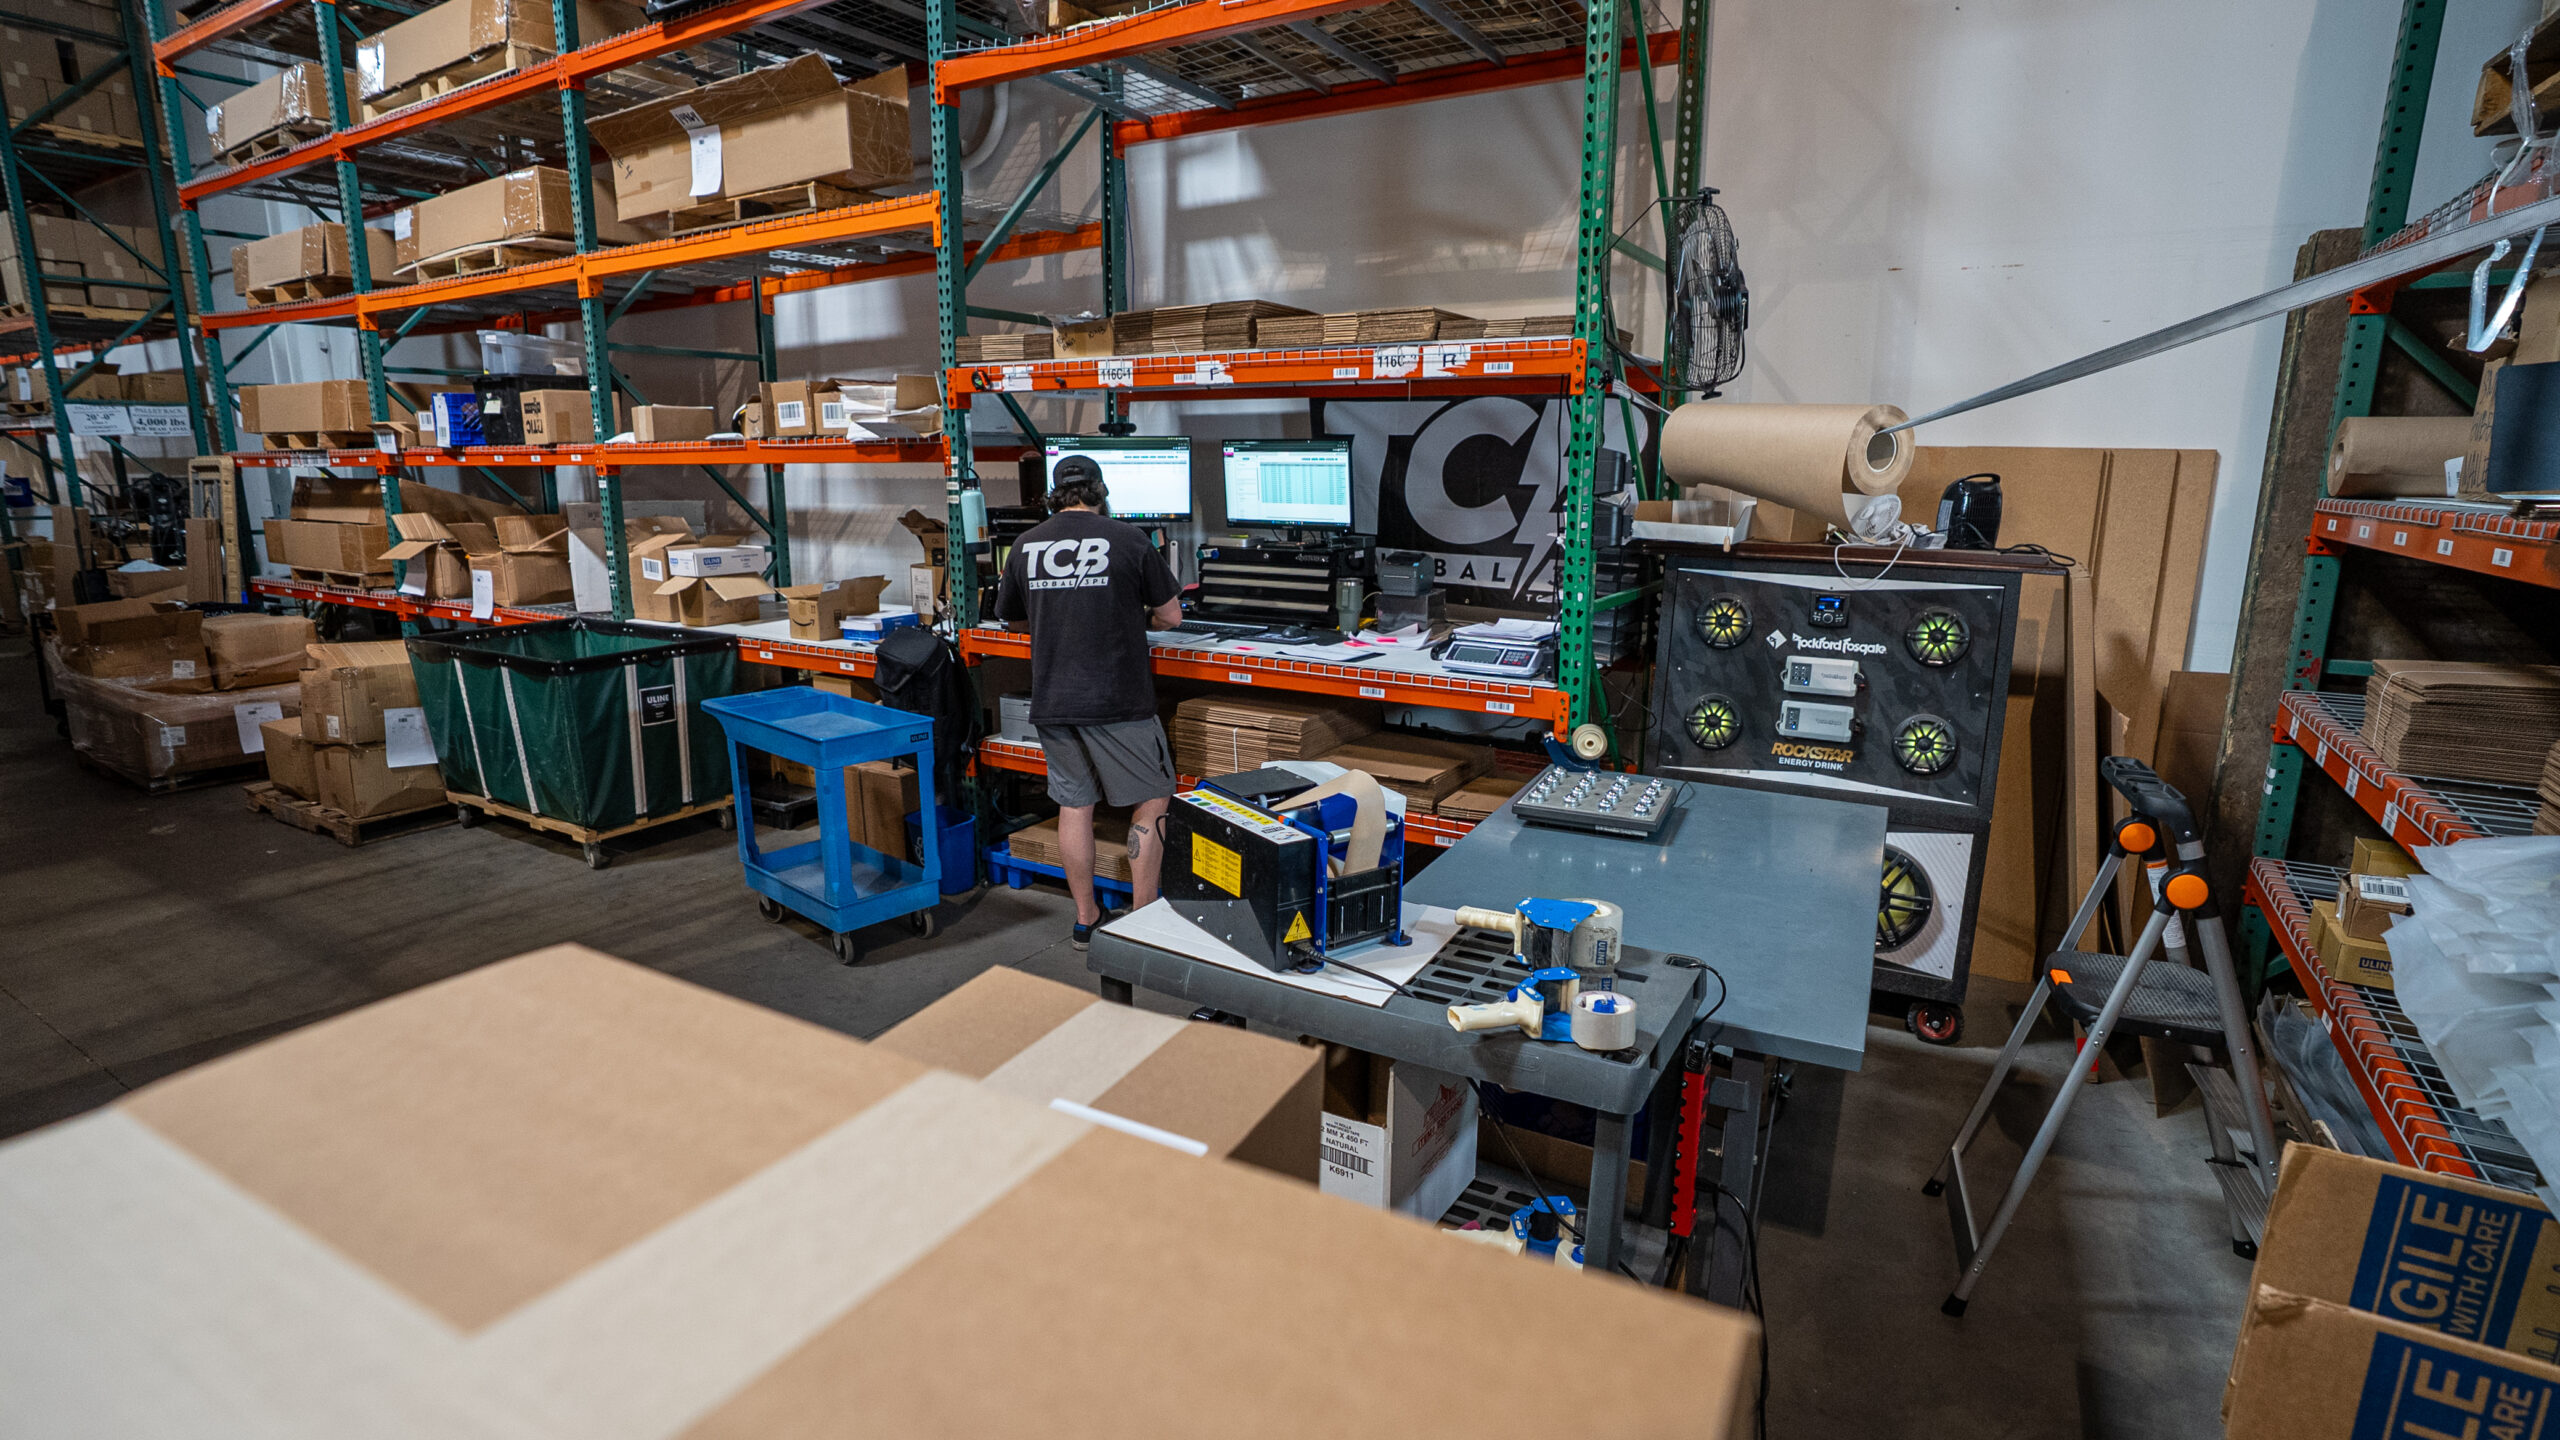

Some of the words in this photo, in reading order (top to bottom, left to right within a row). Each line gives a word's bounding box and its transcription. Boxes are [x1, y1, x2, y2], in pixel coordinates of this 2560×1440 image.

[1100, 368, 1131, 381] 116C-1
[170, 418, 186, 427] lbs
[1021, 537, 1110, 579] TCB
[1084, 578, 1106, 586] 3PL
[1791, 632, 1842, 651] Rockford
[1842, 637, 1888, 656] Fosgate
[646, 693, 669, 704] ULINE
[1771, 742, 1855, 764] ROCKSTAR
[1778, 757, 1814, 768] ENERGY
[1814, 761, 1845, 772] DRINK
[1597, 941, 1606, 965] ULINE
[1326, 1127, 1338, 1136] MM
[1339, 1132, 1345, 1140] X
[1346, 1134, 1359, 1144] 450
[1325, 1136, 1359, 1154] NATURAL
[1329, 1164, 1354, 1180] K6911
[2465, 1208, 2508, 1274] CARE
[2447, 1275, 2489, 1336] WITH
